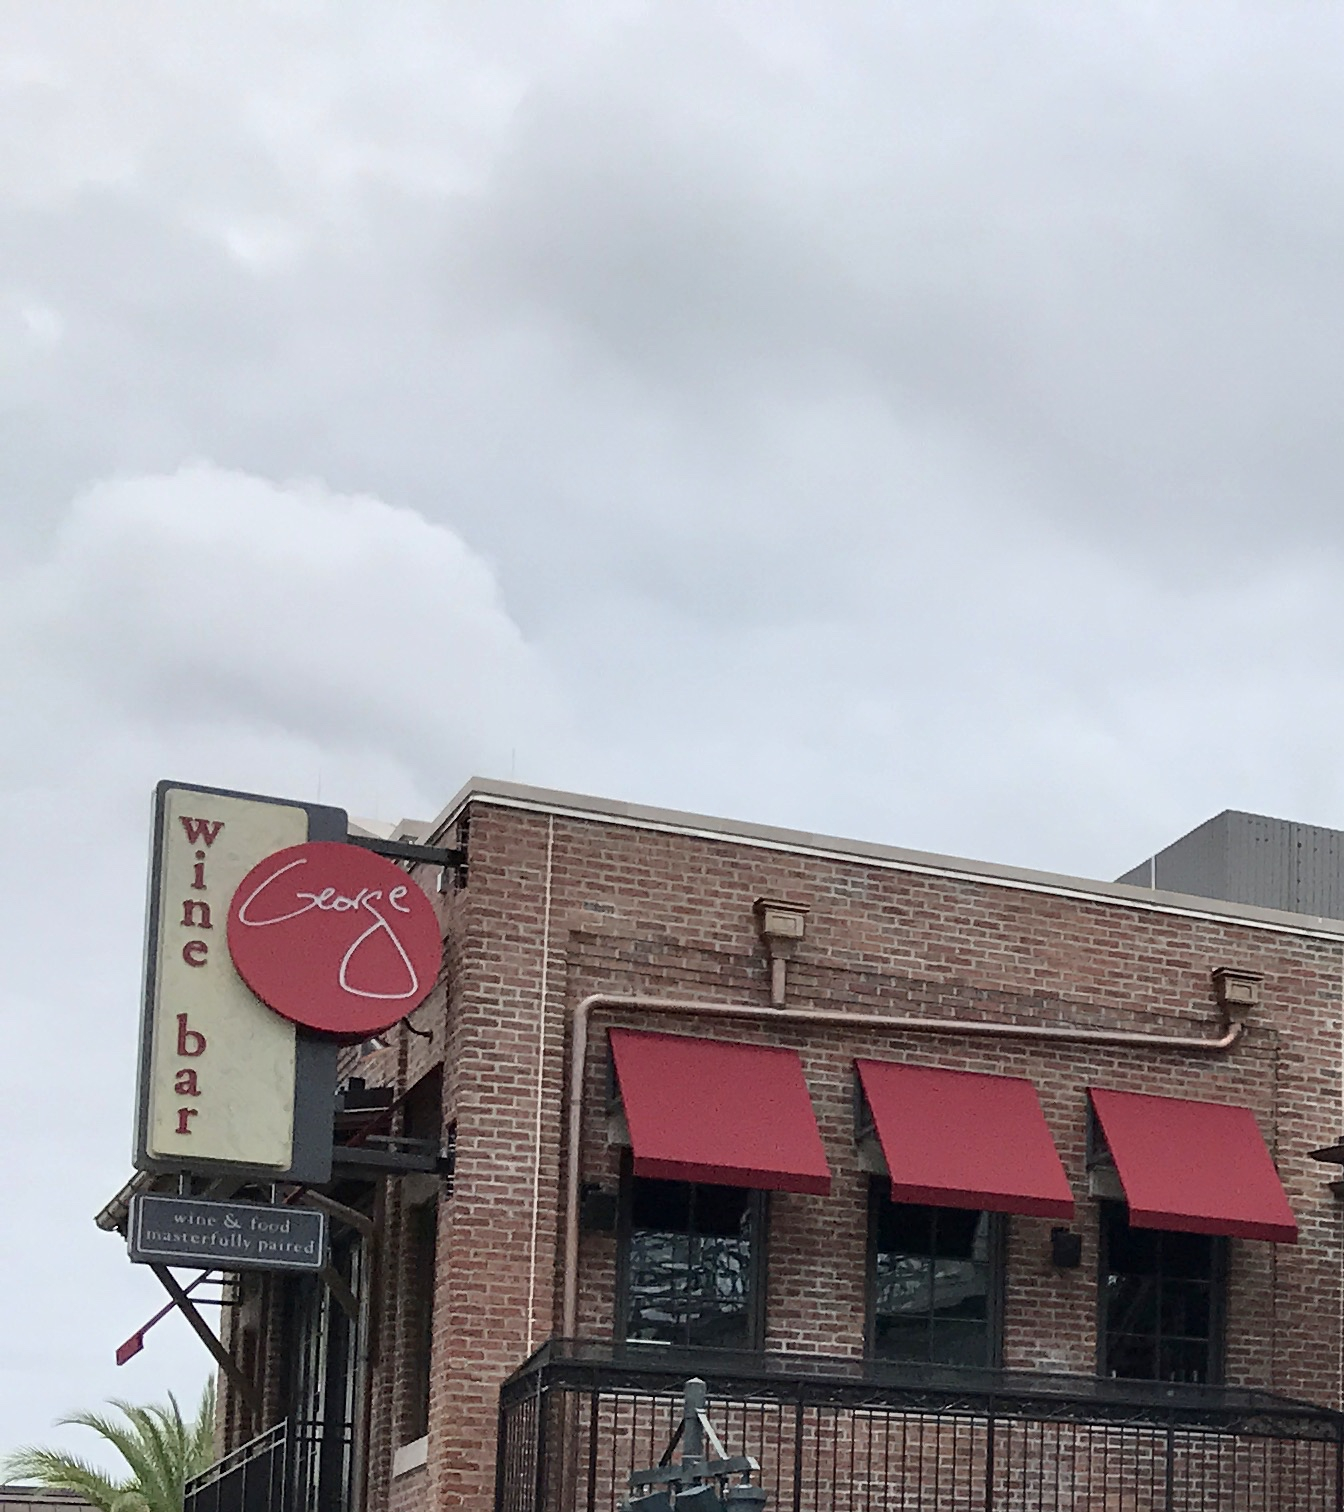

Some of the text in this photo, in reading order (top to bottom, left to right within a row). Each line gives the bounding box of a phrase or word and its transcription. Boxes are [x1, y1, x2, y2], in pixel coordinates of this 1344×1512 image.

[238, 858, 418, 999] George
[174, 815, 225, 1135] wine bar
[146, 1230, 315, 1255] masterfully paired
[174, 1212, 291, 1234] wine & food
